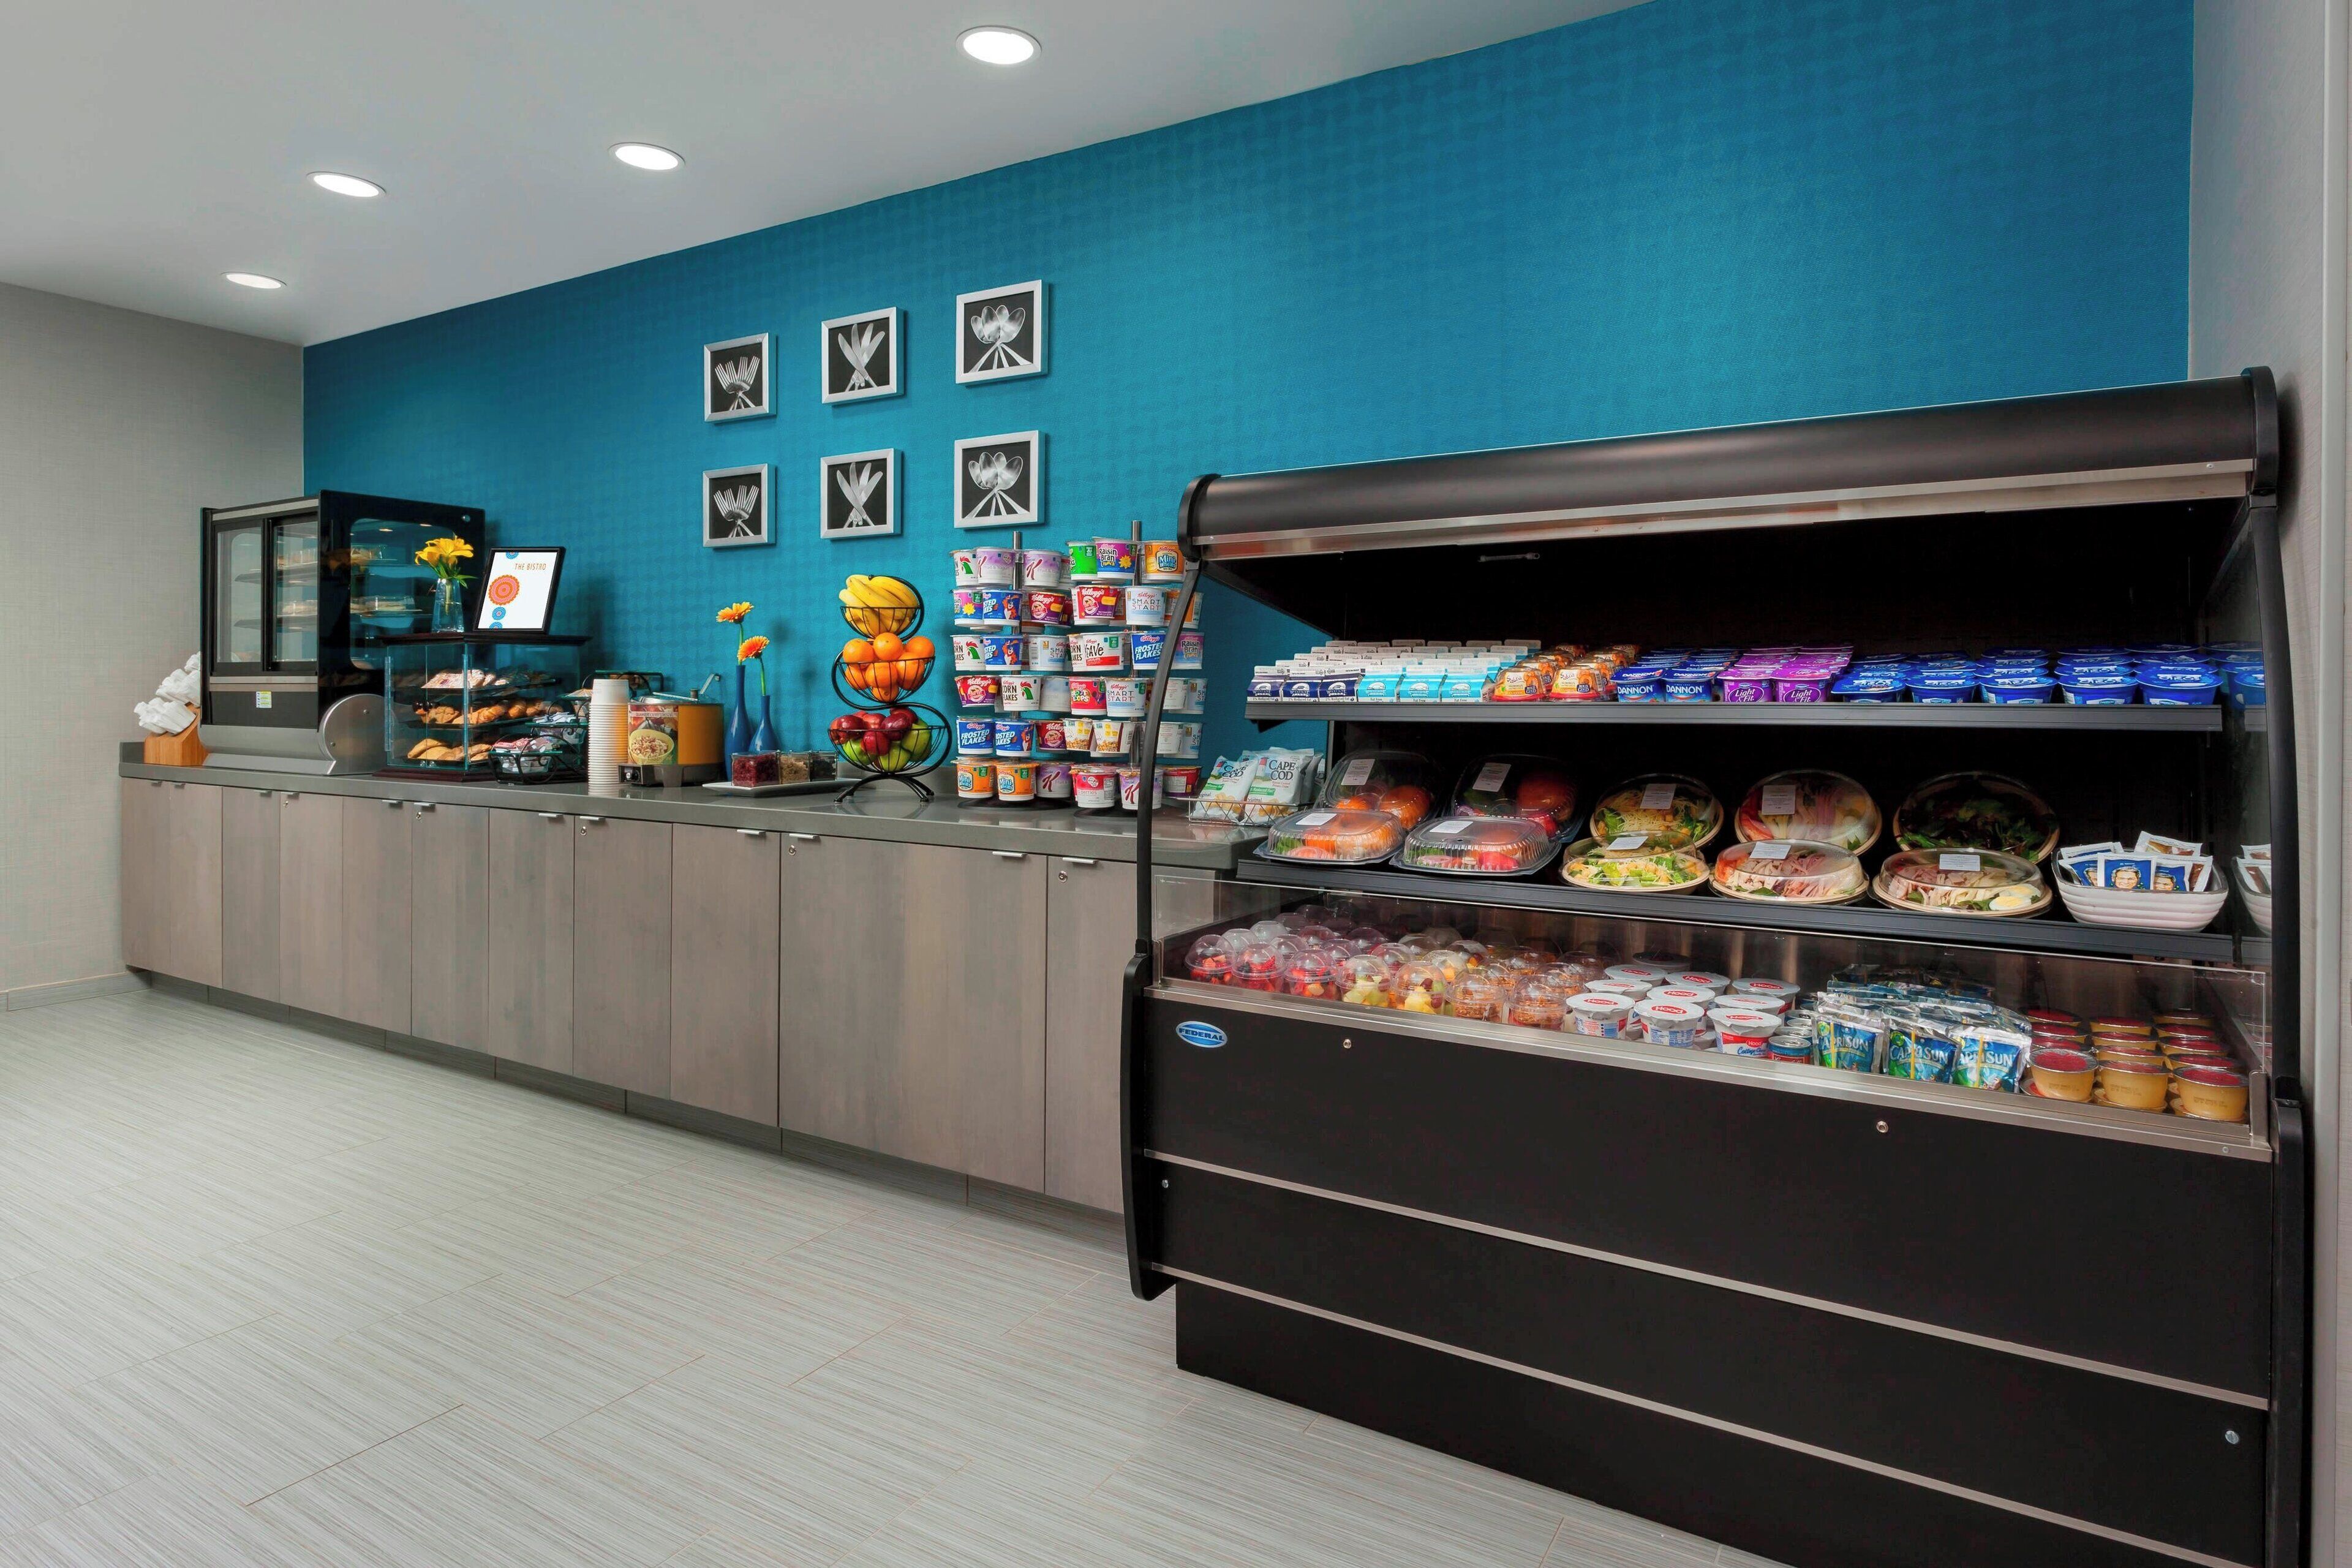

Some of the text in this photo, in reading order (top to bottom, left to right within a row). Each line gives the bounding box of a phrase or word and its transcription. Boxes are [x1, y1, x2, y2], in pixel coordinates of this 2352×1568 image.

[1026, 558, 1042, 580] K
[1081, 587, 1105, 598] Kellogg's
[1031, 594, 1055, 605] Kellogg's
[1070, 645, 1081, 654] ORN
[1136, 649, 1161, 661] FLAKES
[967, 677, 992, 687] Kellogg's
[1617, 685, 1654, 695] DANNON
[1666, 685, 1703, 694] DANNON
[1735, 688, 1756, 698] Light
[1791, 688, 1812, 699] Light
[960, 729, 990, 739] FROSTED
[961, 736, 987, 746] FLAKES
[1268, 760, 1296, 771] CAPE
[1270, 770, 1294, 781] COD
[1042, 771, 1061, 792] K
[1656, 1006, 1683, 1014] Hood
[1179, 1028, 1225, 1041] FEDERAL
